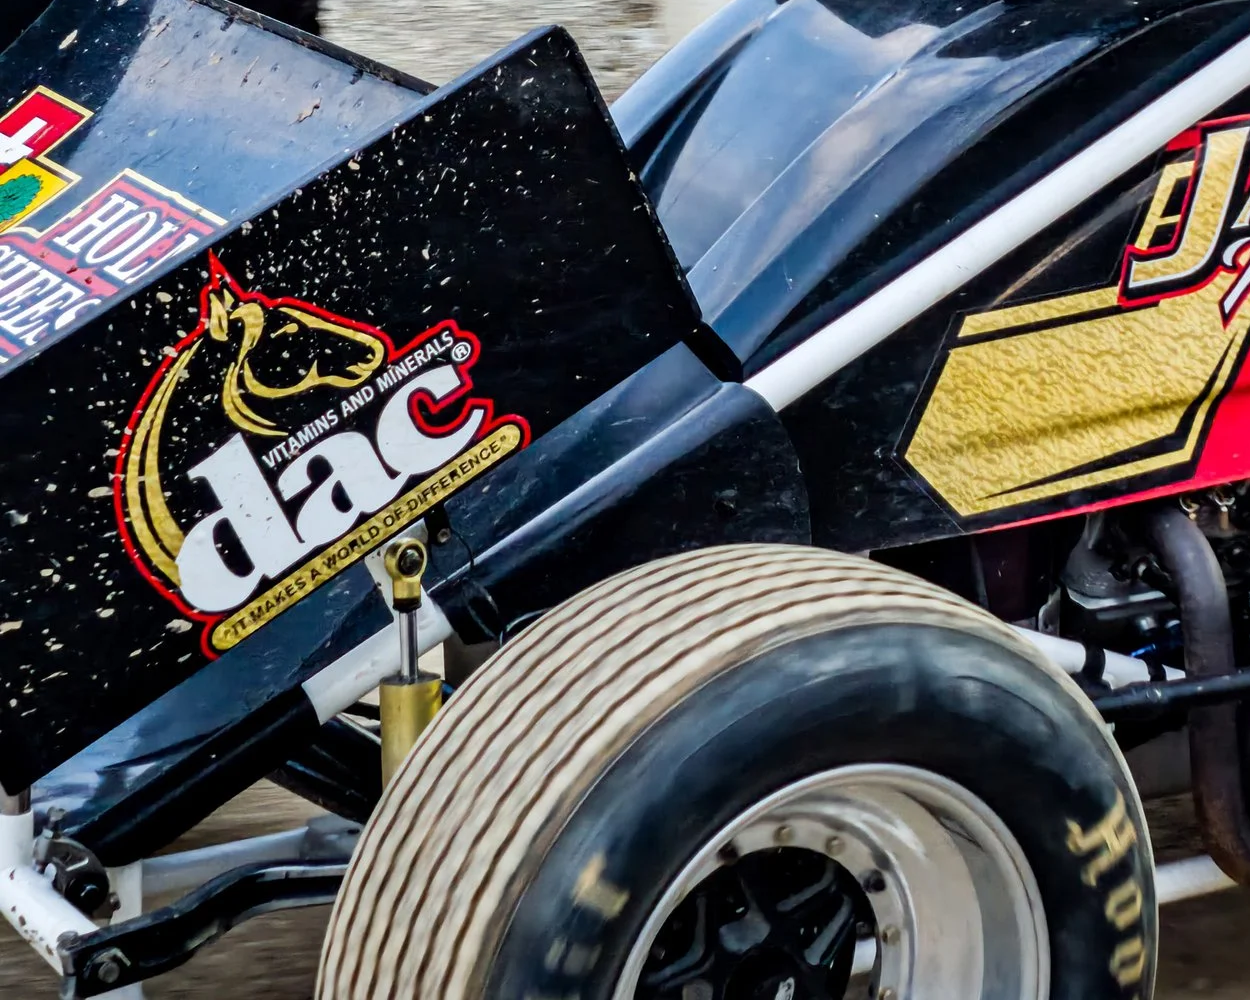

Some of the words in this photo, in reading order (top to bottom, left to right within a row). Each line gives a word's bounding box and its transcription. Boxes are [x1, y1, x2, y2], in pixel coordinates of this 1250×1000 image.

[261, 411, 341, 469] VITAMINS
[341, 385, 375, 418] AND
[376, 330, 454, 394] MINERALS
[174, 363, 485, 615] dac
[250, 576, 307, 621] MAKES
[309, 565, 323, 581] A
[323, 524, 381, 569] WORLD
[383, 507, 405, 530] OF
